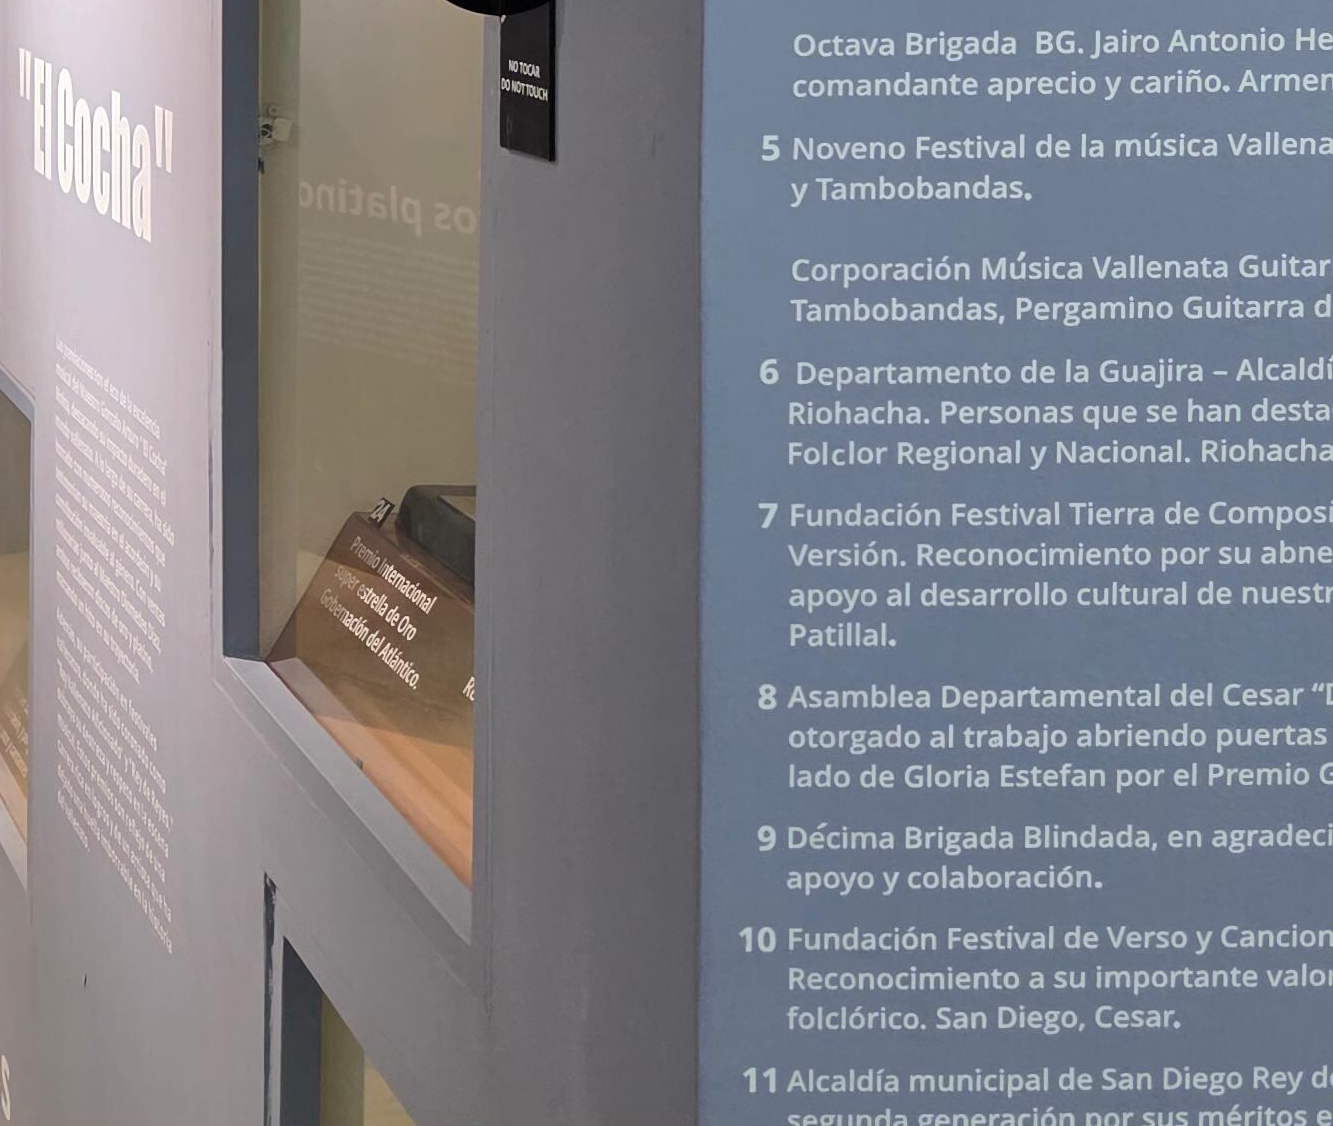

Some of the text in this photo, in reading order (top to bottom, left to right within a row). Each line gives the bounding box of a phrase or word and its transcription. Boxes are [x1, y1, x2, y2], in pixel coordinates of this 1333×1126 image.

[793, 26, 1333, 62] Octava Brigada BG. Jairo Antonio He
[508, 59, 541, 79] NO TOCAR
[501, 77, 549, 103] DO NOT TOUCH
[761, 131, 1333, 162] 5 Noveno Festival de la música Vallena
[789, 174, 1033, 208] y Tambobandas.
[791, 250, 1332, 289] Corporación Música Vallenata Guitar
[759, 358, 779, 385] 6
[796, 361, 1012, 392] Departamento
[1020, 359, 1056, 384] de
[1065, 358, 1090, 383] la
[1099, 357, 1204, 389] Guajira
[349, 536, 438, 616] Premio Internacional
[356, 584, 390, 618] estrella
[385, 605, 400, 627] de
[396, 616, 418, 642] Oro
[319, 588, 421, 690] Gobernación del Atlántico.
[790, 622, 897, 647] Patillal.
[757, 822, 1333, 856] 9 Décima Brigada Blindada, en agradeci
[786, 864, 1103, 896] apoyo y colaboración.
[738, 923, 1333, 955] 10 Fundación Festival de Verso y Cancion
[786, 1004, 1181, 1035] folclórico. San Diego, Cesar.
[742, 1067, 777, 1094] 11
[786, 1068, 900, 1093] Alcaldía
[909, 1067, 1049, 1099] municipal
[1058, 1066, 1094, 1091] de
[1101, 1067, 1153, 1091] San
[1163, 1065, 1243, 1096] Diego
[1252, 1066, 1304, 1096] Rey
